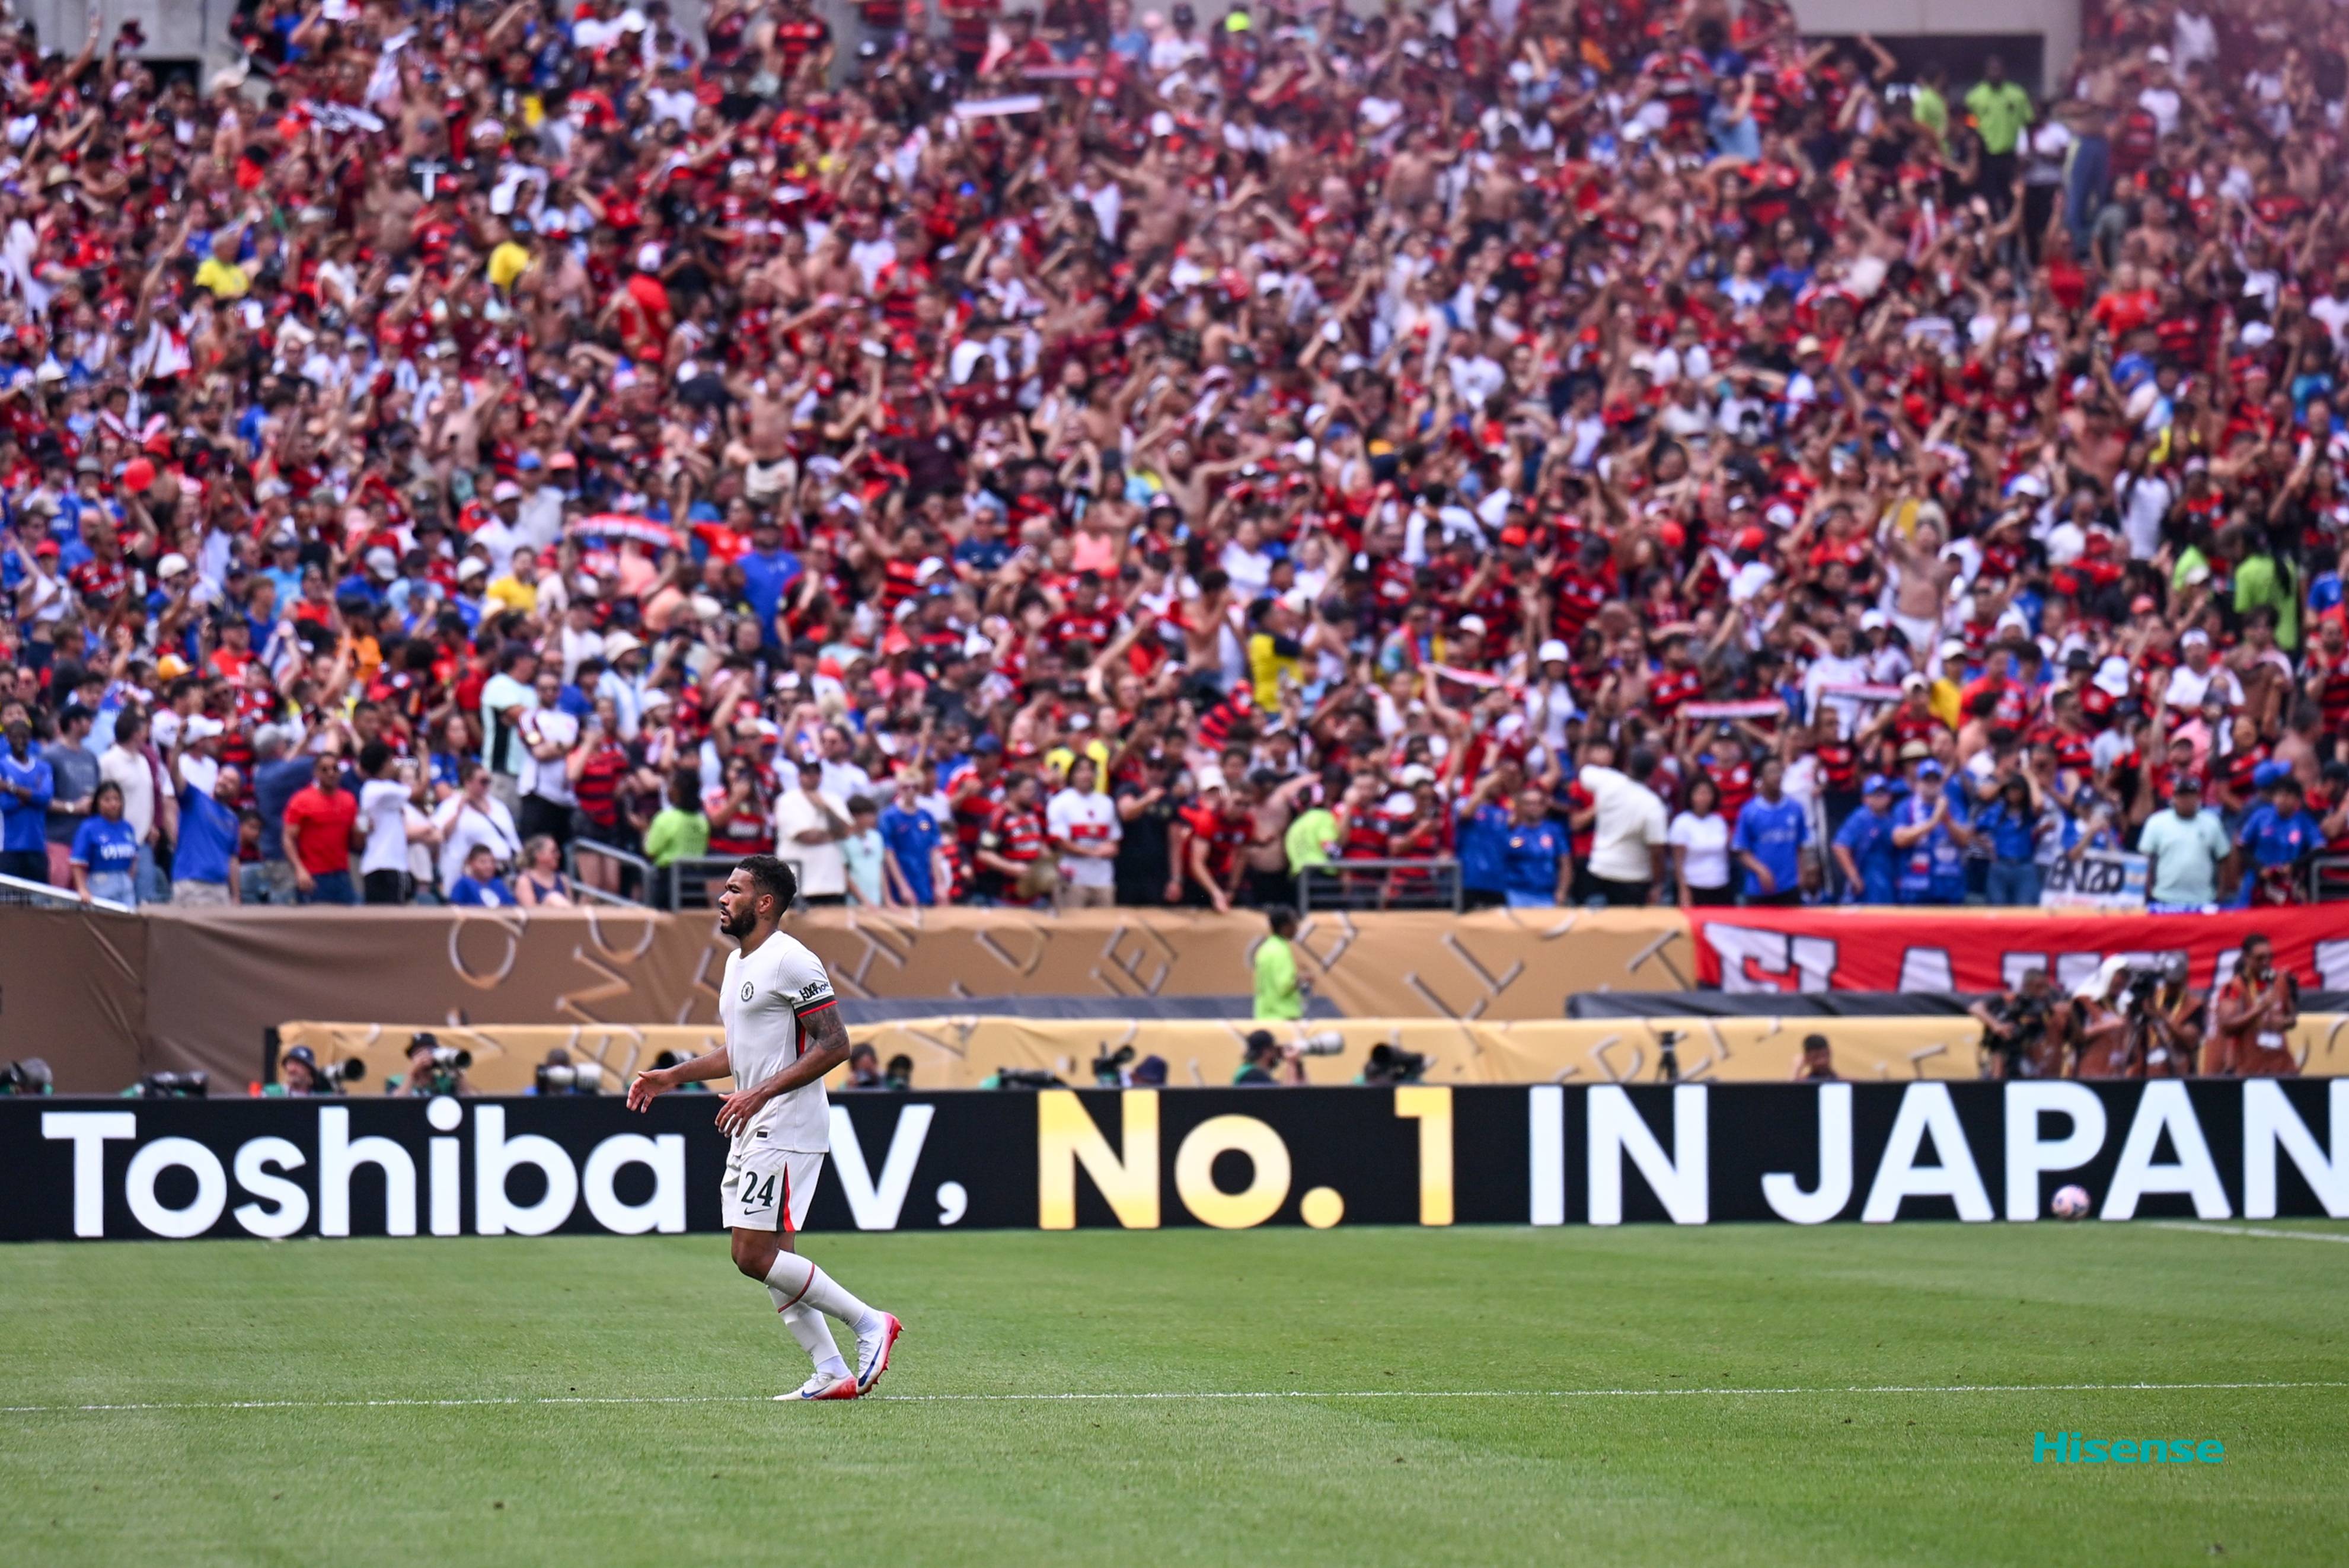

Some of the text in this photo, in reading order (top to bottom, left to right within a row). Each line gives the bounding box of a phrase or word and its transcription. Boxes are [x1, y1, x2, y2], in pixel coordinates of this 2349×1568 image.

[42, 1078, 2349, 1238] Toshiba V, No. 1 IN JAPAN
[741, 1171, 775, 1208] 24
